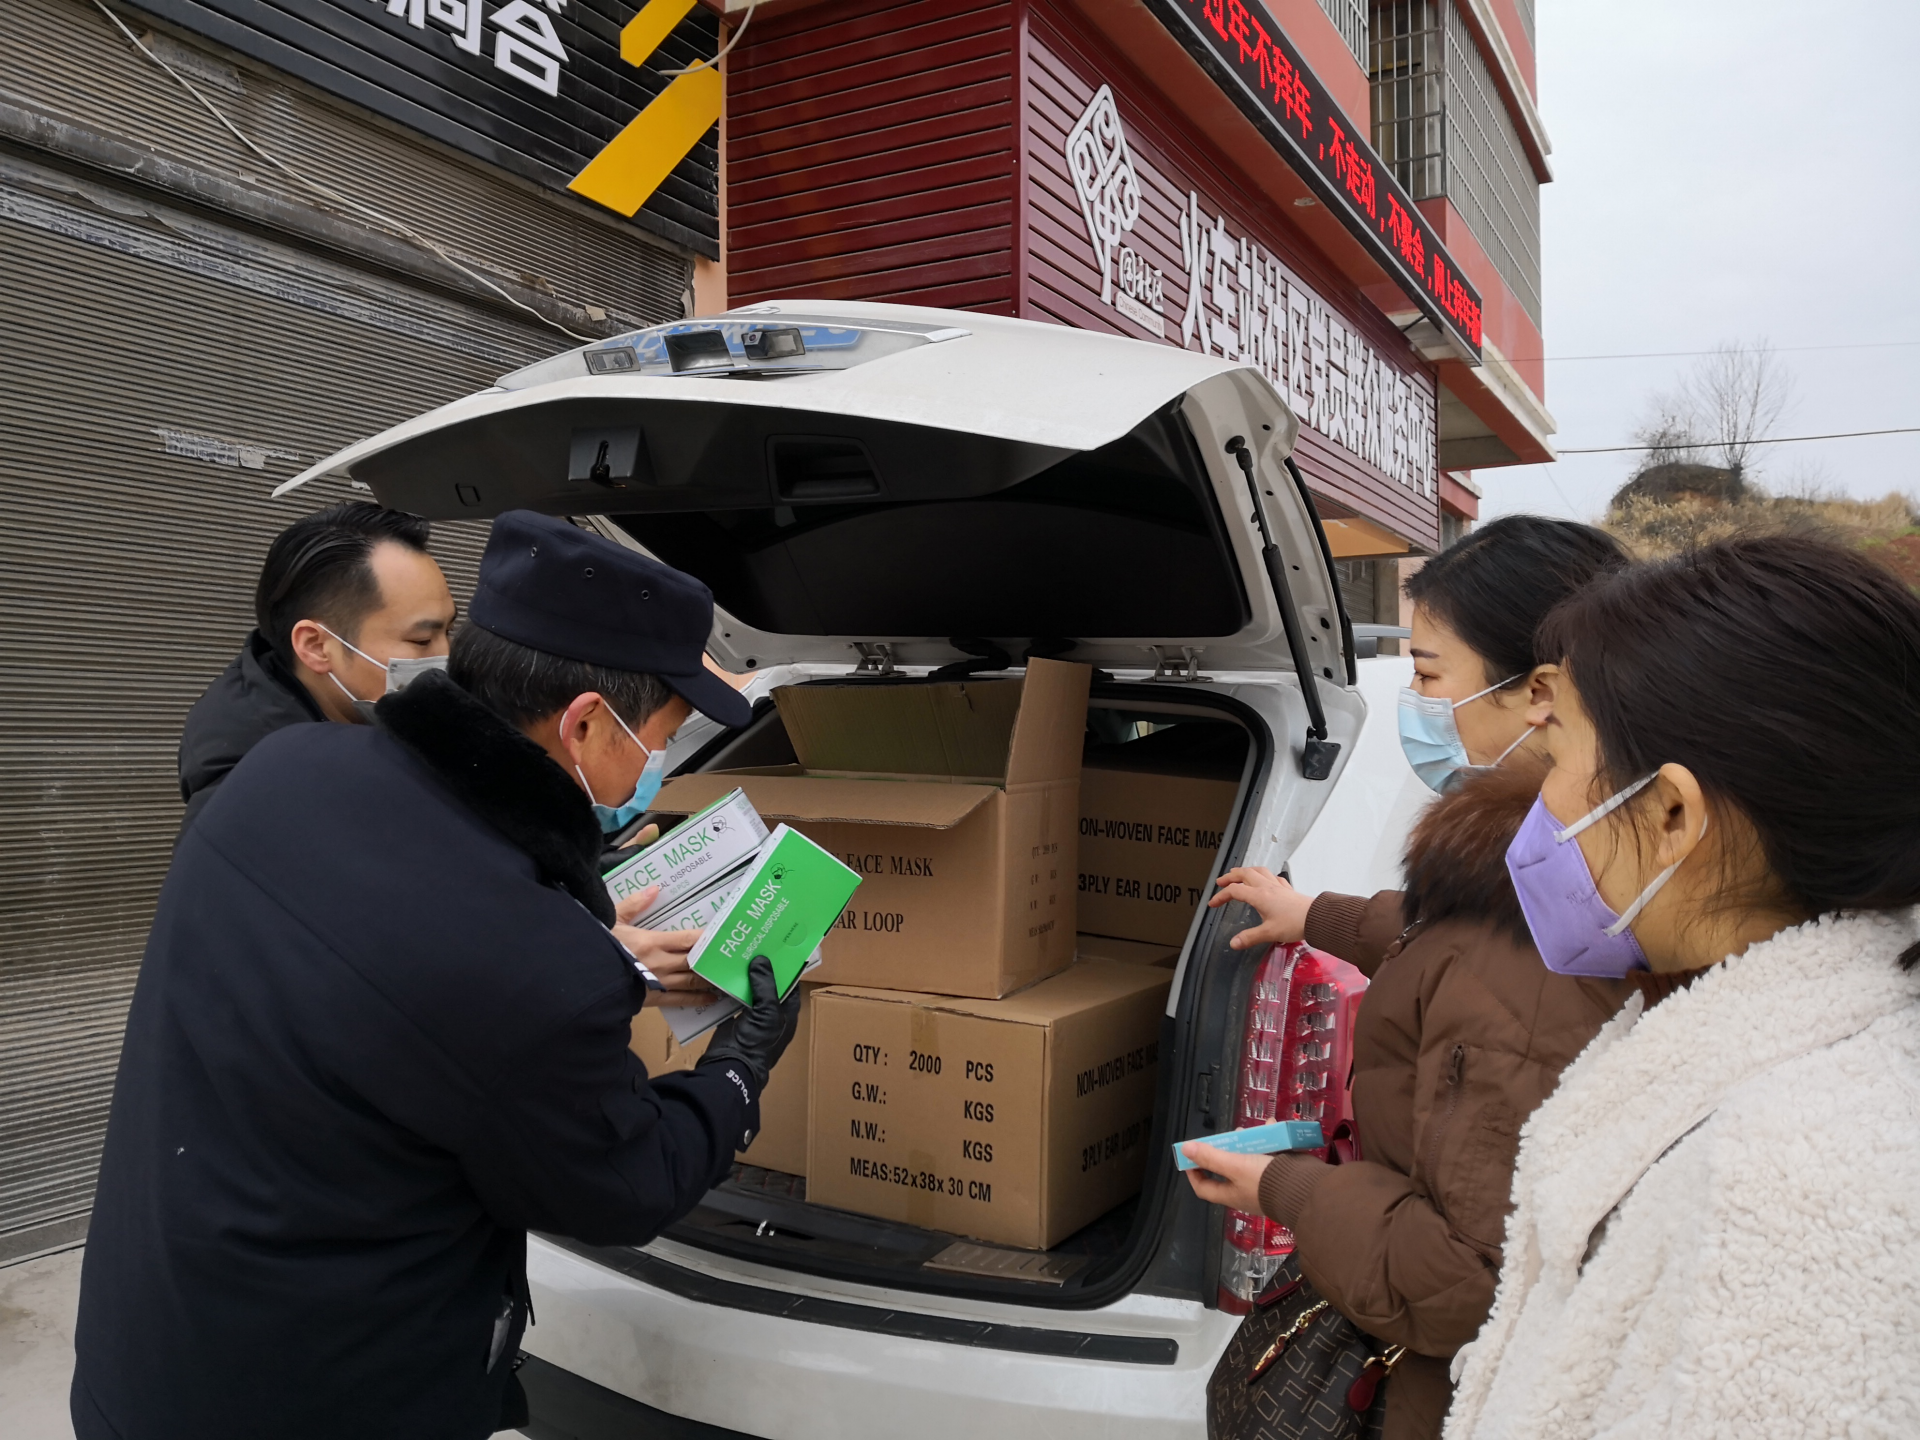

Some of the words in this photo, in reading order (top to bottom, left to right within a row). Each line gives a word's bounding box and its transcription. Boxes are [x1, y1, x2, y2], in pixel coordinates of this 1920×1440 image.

[1190, 0, 1481, 347] 过年不拜年，不走动，不聚会，网上拜年新
[1118, 295, 1138, 317] Chinese
[1138, 308, 1163, 334] Community
[1180, 190, 1432, 498] 火车站社区党员群众服务中心
[1157, 825, 1190, 847] FACE
[614, 862, 661, 900] FACE
[663, 827, 716, 869] MASK
[670, 851, 713, 880] DISPOSABLE
[846, 853, 883, 874] FACE
[890, 855, 933, 877] MASK
[1078, 873, 1110, 894] 3PLY
[1116, 878, 1141, 898] EAR
[1147, 882, 1182, 904] LOOP
[664, 909, 707, 932] ACE
[719, 920, 752, 958] FACE
[748, 878, 782, 921] MASK
[742, 932, 767, 960] SURGICAL
[761, 897, 790, 934] DISPOSABLE
[833, 910, 857, 929] AR
[863, 911, 904, 933] LOOP
[909, 1050, 942, 1075] 2000
[965, 1060, 994, 1083] PCS
[1077, 1055, 1125, 1098] NON-WOVEN
[1127, 1047, 1144, 1075] FACE
[725, 1069, 751, 1105] POLICE
[852, 1081, 887, 1105] G.W.:
[964, 1100, 994, 1123] KGS
[851, 1119, 886, 1143] N.W.:
[963, 1140, 993, 1163] KGS
[1082, 1139, 1103, 1172] 3PLY
[1105, 1132, 1120, 1160] EAR
[1122, 1121, 1141, 1151] LOOP
[948, 1176, 964, 1197] 30
[968, 1180, 991, 1203] CM
